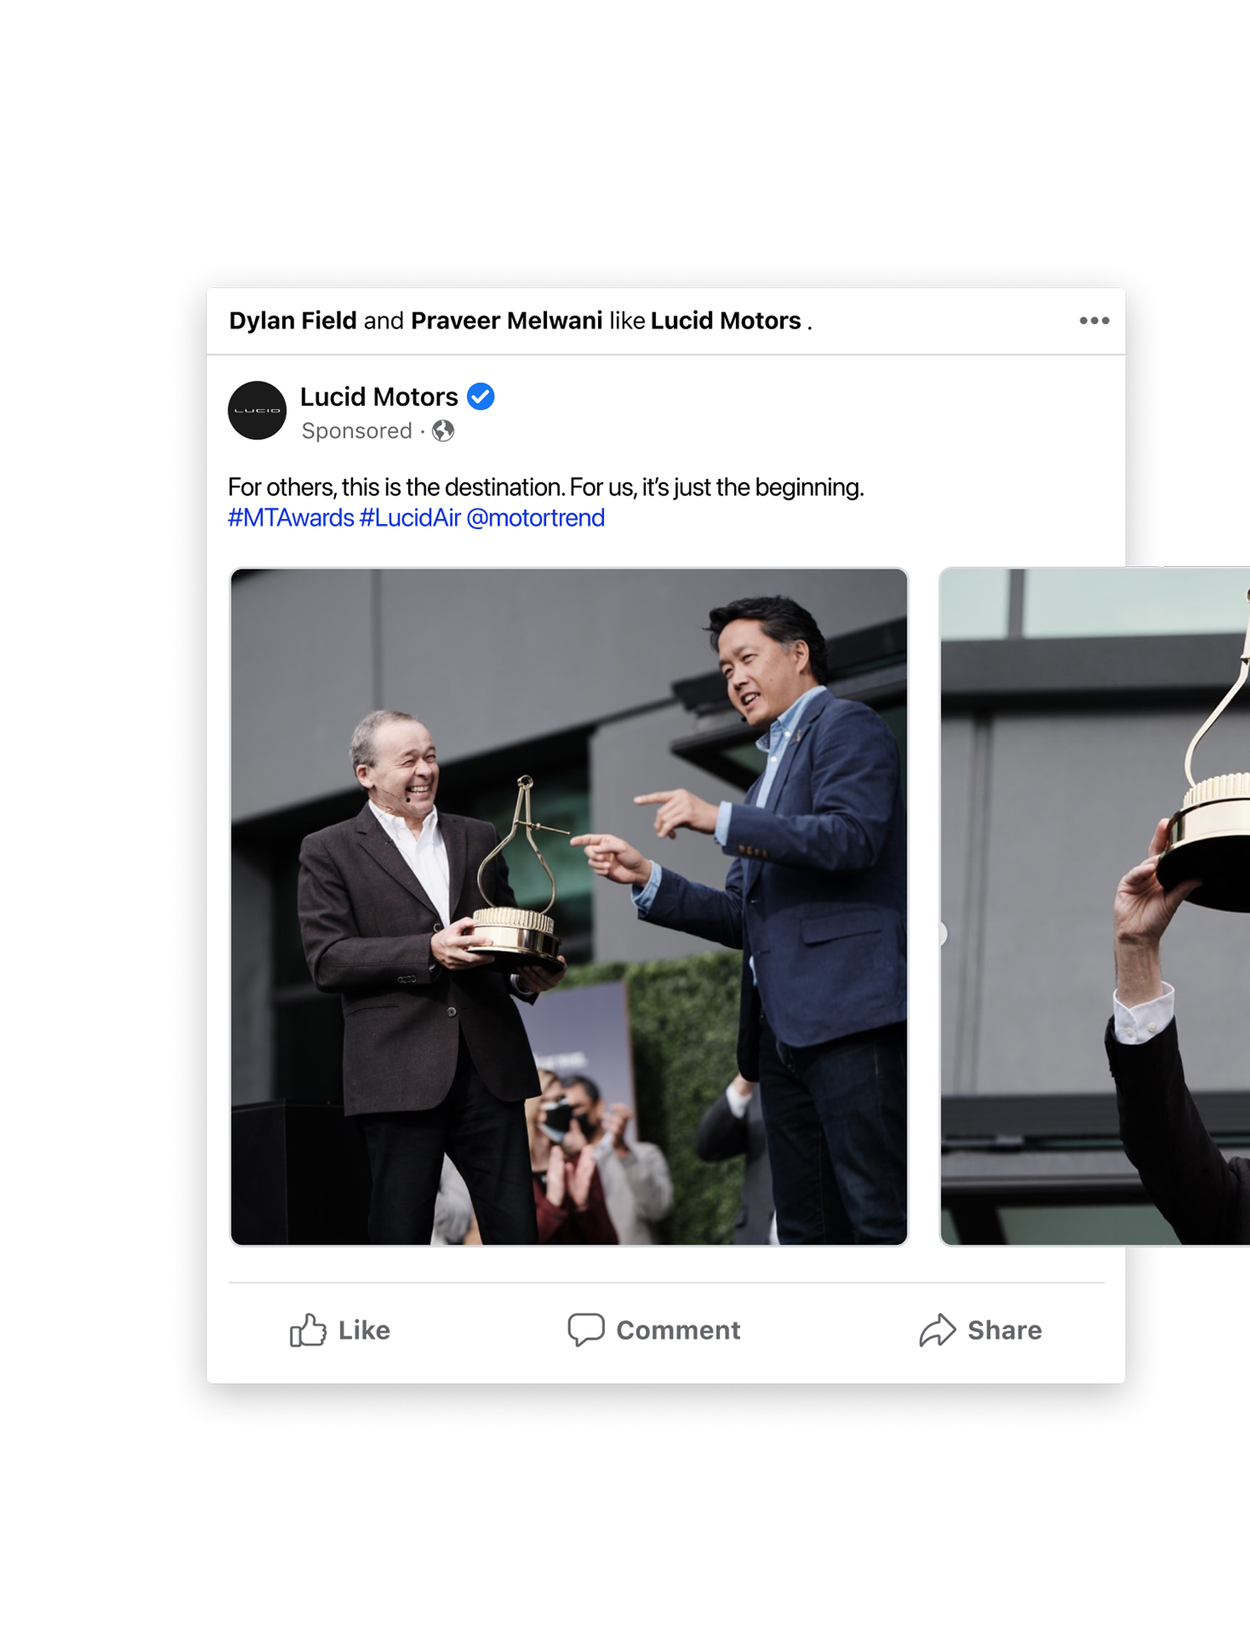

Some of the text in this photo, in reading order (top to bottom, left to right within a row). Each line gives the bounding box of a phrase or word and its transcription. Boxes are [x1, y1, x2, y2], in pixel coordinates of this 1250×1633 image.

[229, 310, 295, 335] Dylan
[302, 309, 357, 330] Field
[363, 310, 404, 330] and
[411, 311, 502, 330] Praveer
[507, 309, 603, 330] Melwani
[610, 310, 646, 330] like
[651, 309, 714, 330] Lucid
[720, 311, 802, 330] Motors
[300, 385, 459, 407] Lucid Motors
[302, 421, 412, 443] Sponsored
[228, 476, 263, 497] For
[266, 476, 338, 501] others,
[341, 476, 380, 497] this
[385, 476, 402, 497] is
[405, 476, 441, 497] the
[444, 476, 566, 497] destination.
[570, 476, 605, 497] For
[608, 481, 638, 501] us,
[672, 476, 712, 501] just
[715, 476, 751, 497] the
[755, 476, 865, 502] beginning.
[227, 507, 605, 530] #MTAwards #LucidAir @motortrend
[339, 1318, 391, 1341] Like
[616, 1319, 741, 1341] Comment
[968, 1319, 1043, 1341] Share
